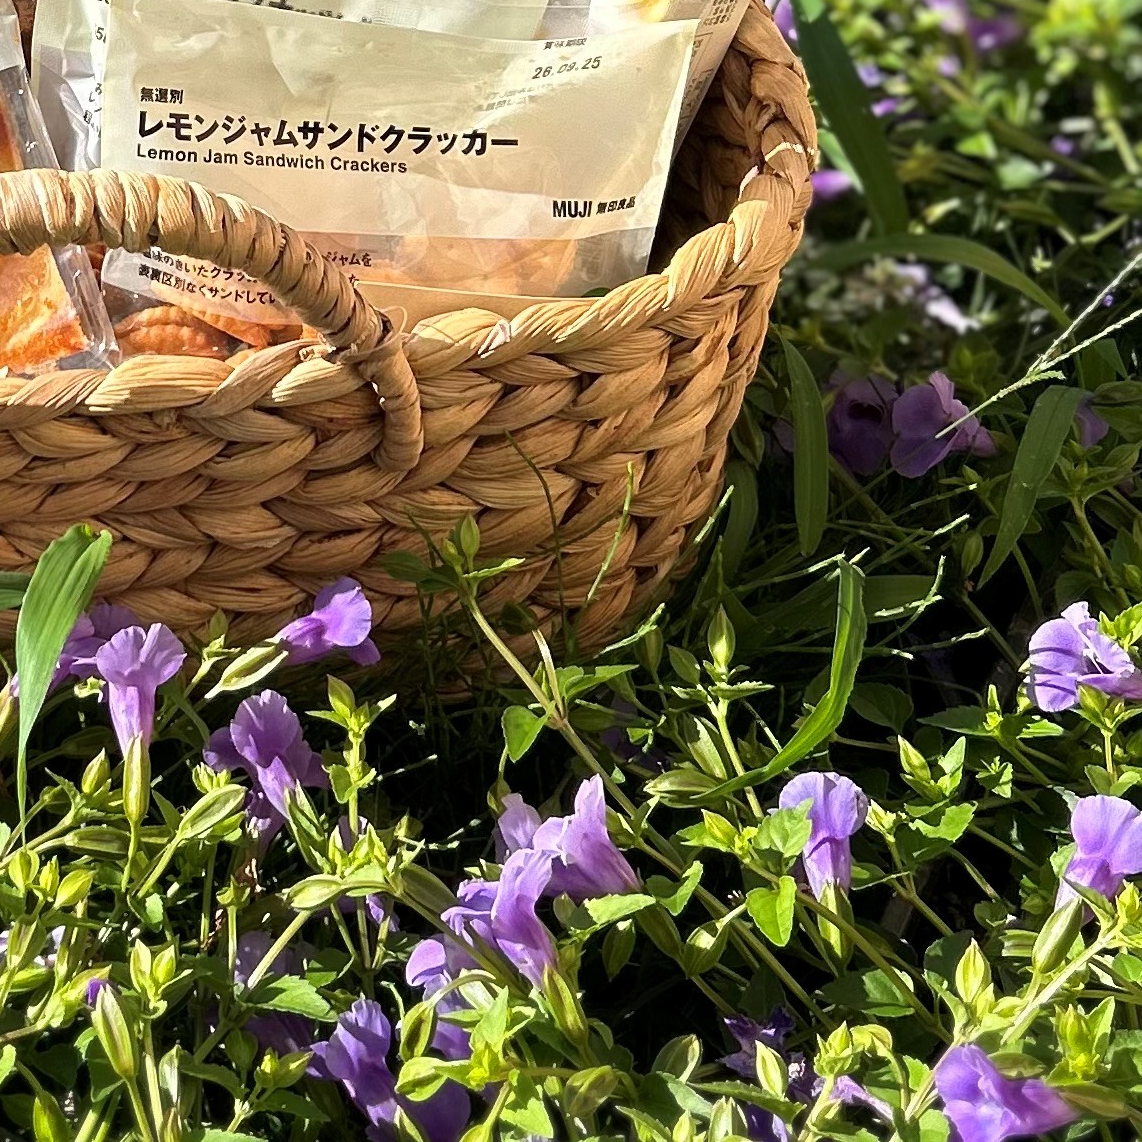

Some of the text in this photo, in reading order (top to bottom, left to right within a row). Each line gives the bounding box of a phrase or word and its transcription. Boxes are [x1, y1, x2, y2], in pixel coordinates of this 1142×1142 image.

[531, 55, 603, 80] 26.09.25
[139, 86, 184, 105] 無選別
[136, 108, 520, 157] レモンジャムサンドクラッカー
[136, 144, 408, 174] Lemon Jam Sandwich Crackers
[552, 194, 638, 219] MUJI 無印良品
